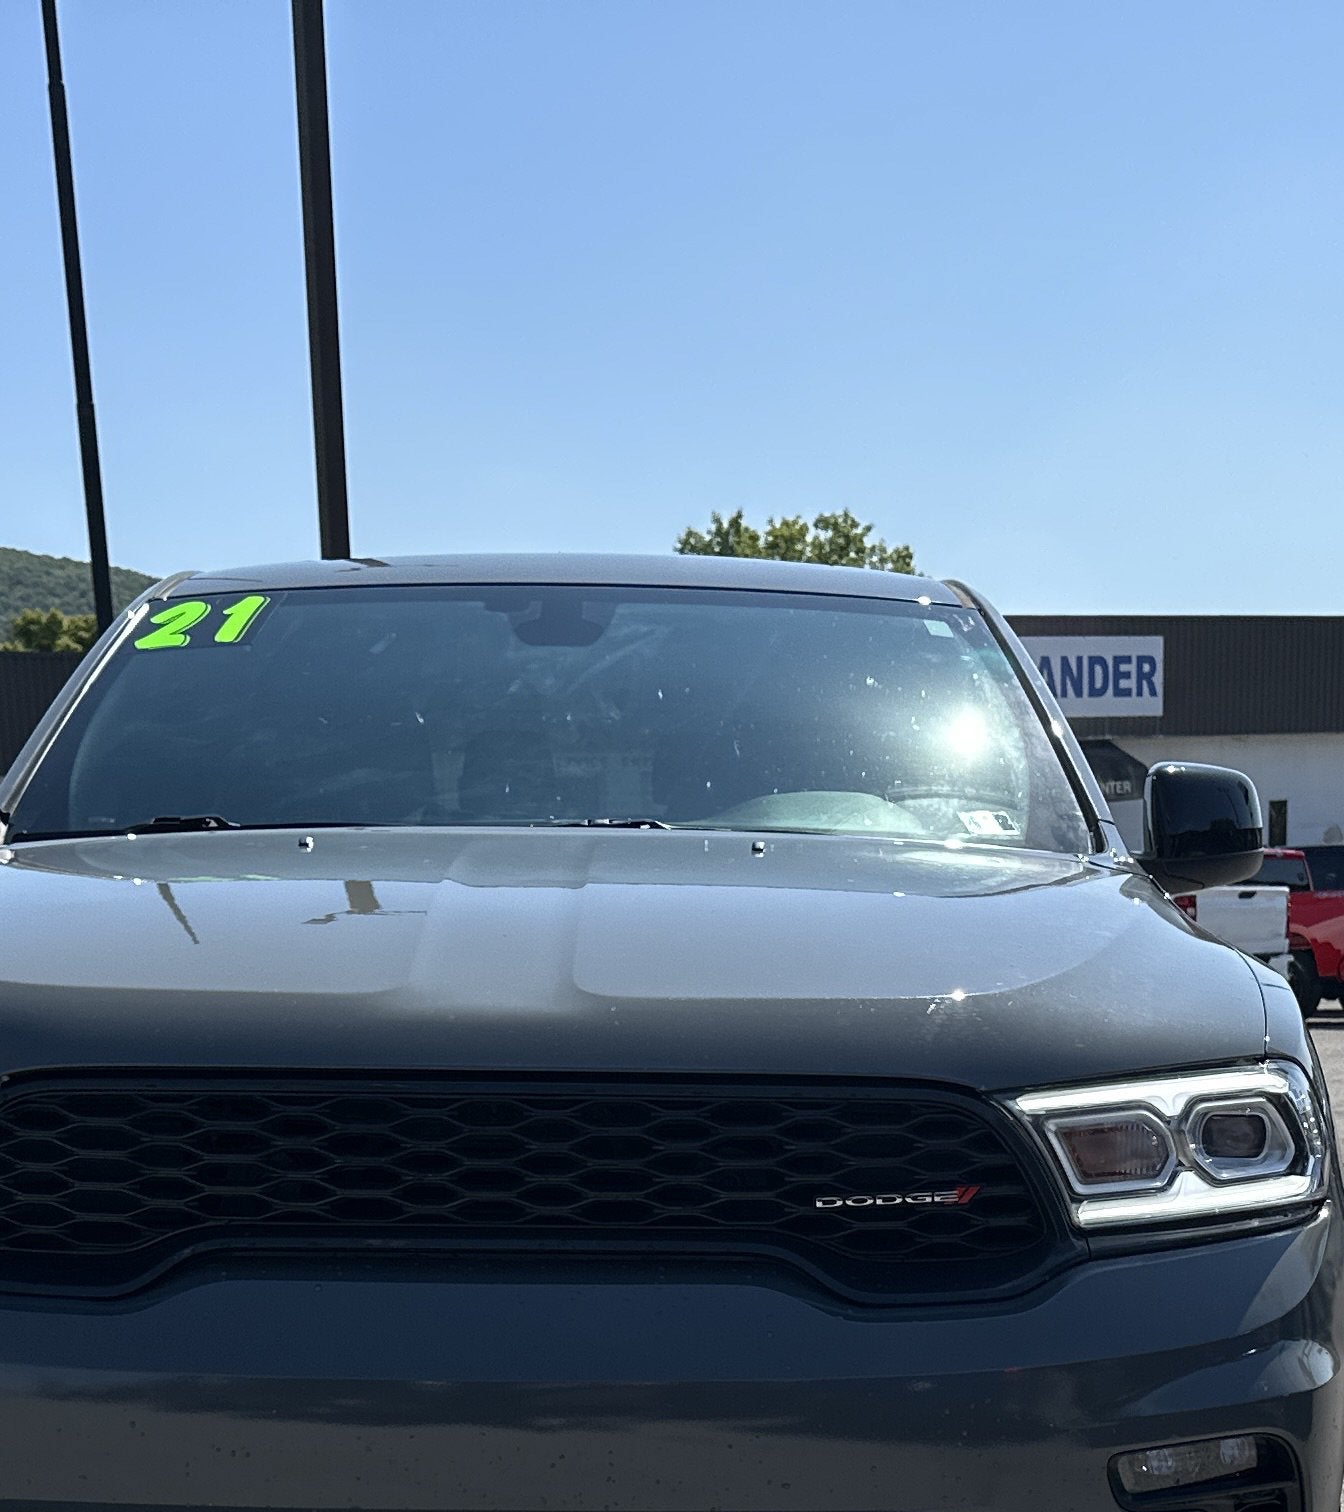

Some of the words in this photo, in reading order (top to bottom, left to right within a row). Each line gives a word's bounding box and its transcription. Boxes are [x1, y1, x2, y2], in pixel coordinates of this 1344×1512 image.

[134, 595, 271, 650] 21
[1038, 655, 1158, 698] ANDER
[815, 1190, 960, 1209] DODGE
